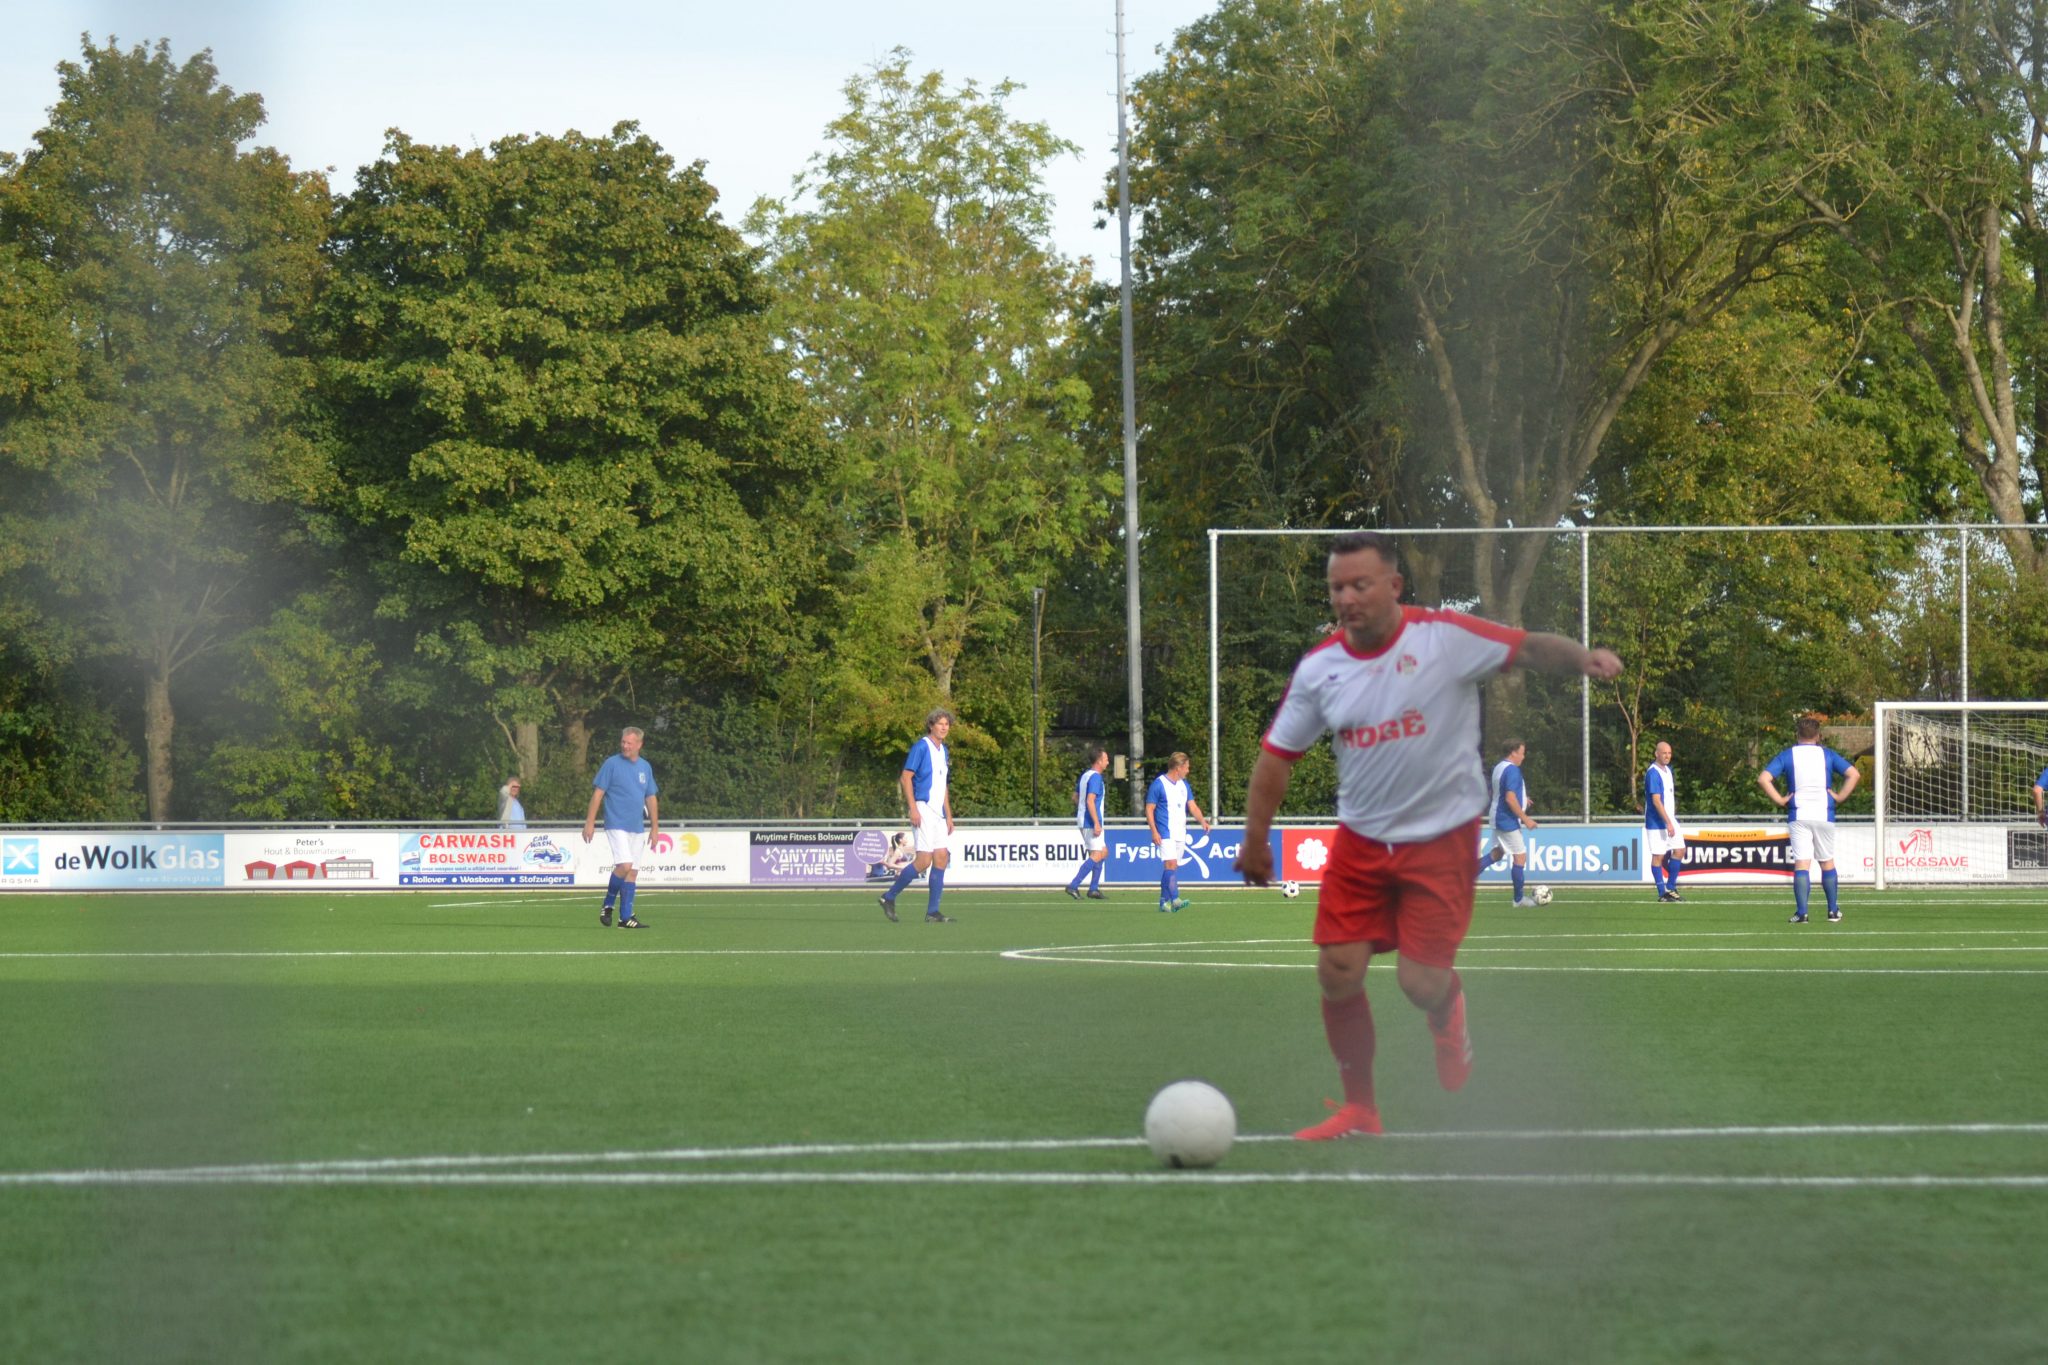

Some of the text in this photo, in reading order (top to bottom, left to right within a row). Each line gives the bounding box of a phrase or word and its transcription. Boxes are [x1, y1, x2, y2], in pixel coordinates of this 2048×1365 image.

[419, 834, 516, 849] CARWASH
[532, 834, 549, 843] CAR
[755, 833, 789, 842] Anytime
[790, 833, 816, 841] Fitness
[818, 832, 853, 841] Bolsward
[296, 838, 324, 847] Peter's
[530, 840, 552, 848] WASH
[293, 847, 357, 856] Bouwmaterialen
[778, 848, 845, 863] ANYTIME
[964, 844, 1039, 861] KUSTERS
[1682, 845, 1796, 864] UMPSTYLE
[429, 853, 507, 864] BOLSWARD
[1863, 857, 1968, 868] CECK&SAVE
[2012, 859, 2041, 868] DIRK
[679, 863, 696, 872] der
[780, 863, 845, 876] FITNESS
[412, 875, 569, 885] Rollover Wasboxen Stofzuigers
